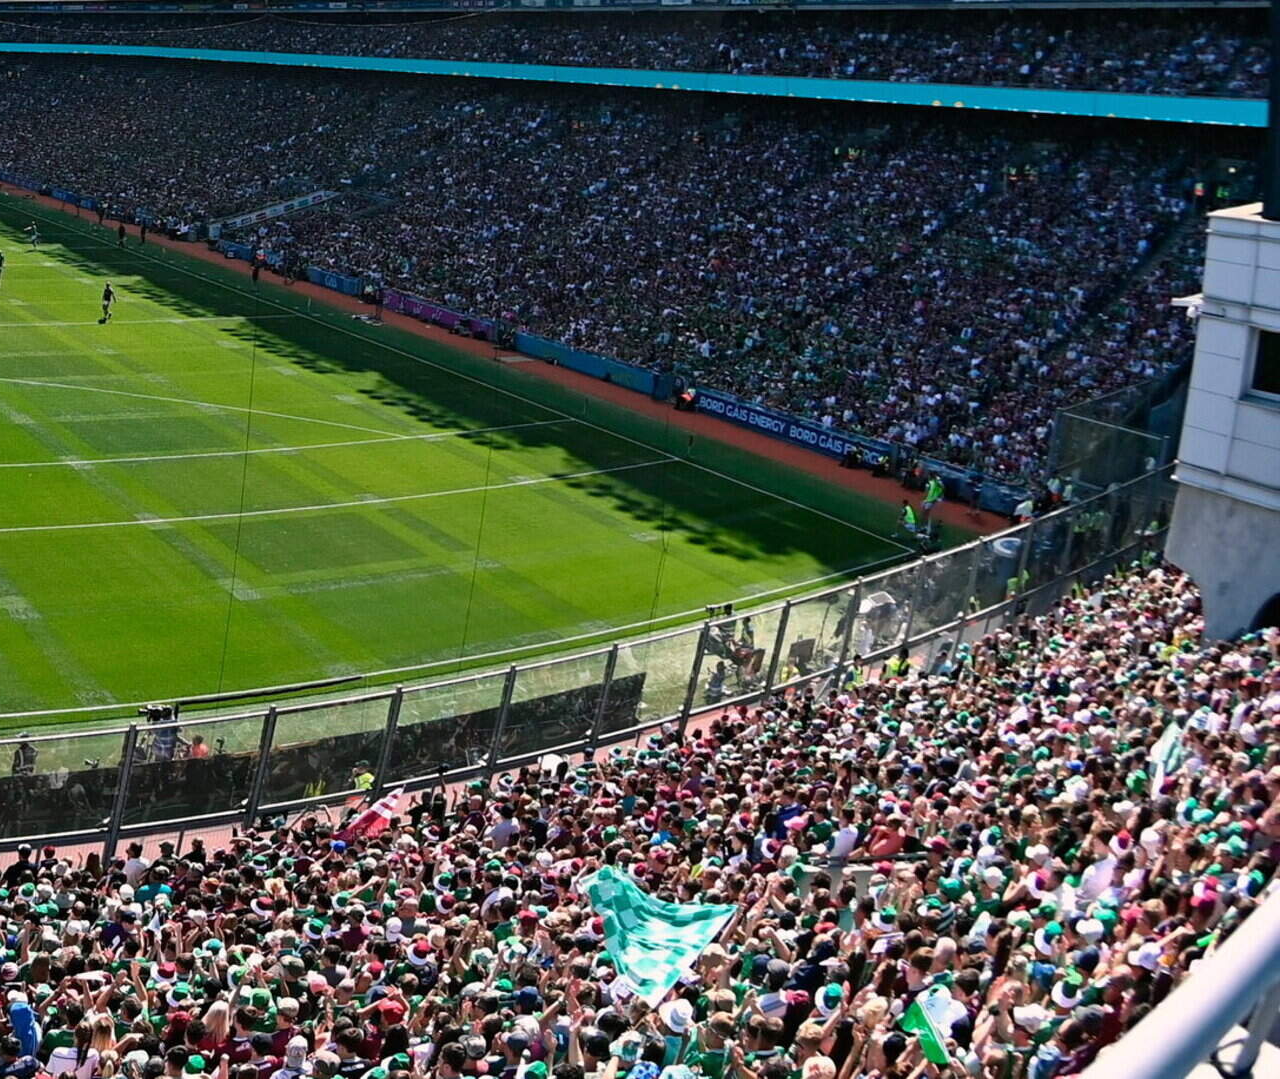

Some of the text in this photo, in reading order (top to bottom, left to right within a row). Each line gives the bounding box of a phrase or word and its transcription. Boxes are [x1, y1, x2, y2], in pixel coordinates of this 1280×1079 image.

[699, 395, 726, 415] BORD
[748, 410, 787, 435] ENERGY
[789, 424, 817, 445] BORD
